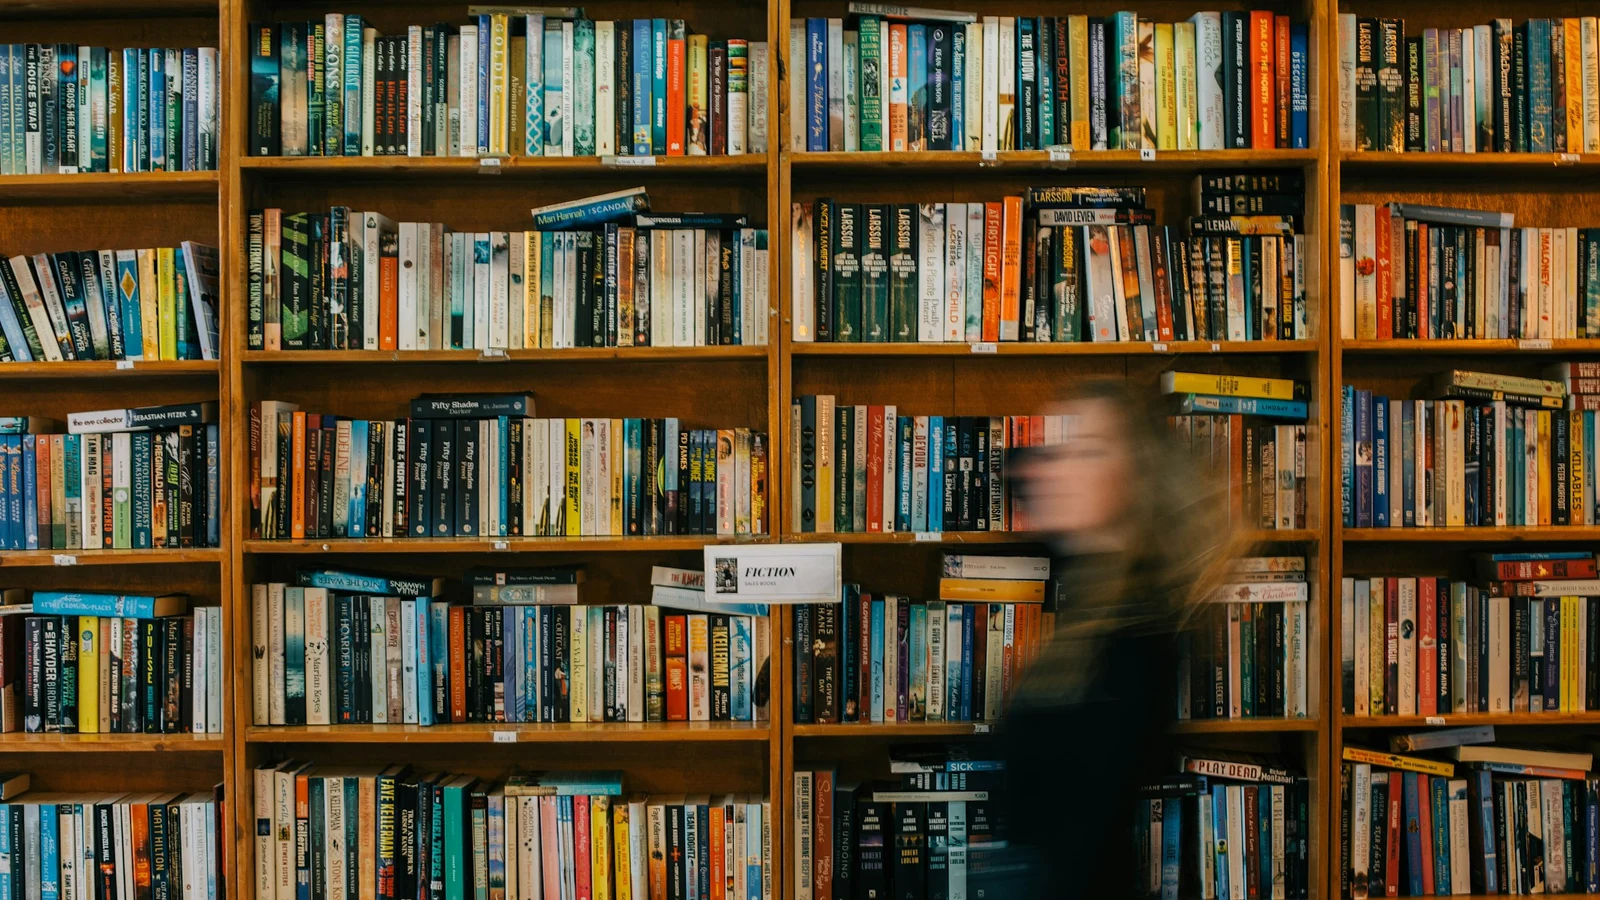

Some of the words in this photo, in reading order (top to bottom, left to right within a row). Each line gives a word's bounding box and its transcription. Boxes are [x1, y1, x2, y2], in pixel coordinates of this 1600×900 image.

[261, 28, 270, 56] GARDNER
[347, 18, 360, 44] ELLEN
[1022, 34, 1032, 49] THE
[1204, 19, 1212, 68] HANCOCK
[1261, 41, 1267, 52] OF
[1359, 23, 1371, 62] LARSSON
[1385, 24, 1397, 63] LARSSON
[326, 45, 339, 89] SONS
[346, 46, 360, 86] GILCHRIST
[494, 24, 503, 93] GOLDIE
[892, 30, 900, 77] detainees
[1021, 50, 1034, 81] WIDOW
[1409, 42, 1418, 83] NICHOLAS
[27, 62, 36, 98] HOUSE
[1292, 52, 1300, 111] DISCOVERER
[1500, 47, 1510, 97] McDermid
[1, 84, 10, 130] MICHAEL
[14, 84, 23, 130] MICHAEL
[67, 83, 75, 108] CROSS
[1043, 77, 1052, 135] mistaken
[1409, 84, 1418, 107] DANE
[28, 102, 37, 129] SWAP
[67, 111, 75, 126] HER
[67, 129, 75, 152] HEART
[250, 214, 262, 232] TONY
[538, 212, 558, 226] Mari
[558, 210, 586, 222] Hannah
[820, 203, 828, 234] ANGELA
[841, 208, 853, 247] LARSSON
[869, 209, 881, 248] LARSSON
[898, 209, 910, 248] LARSSON
[988, 208, 998, 219] AT
[1054, 211, 1072, 222] DAVID
[1073, 211, 1095, 222] LEVIEN
[987, 220, 999, 245] FIRST
[250, 234, 261, 272] HILLERMAN
[820, 236, 828, 271] LAMBERT
[987, 246, 997, 277] LIGHT
[251, 282, 261, 306] TALKING
[950, 291, 958, 323] CHILD
[251, 308, 261, 320] GOD
[310, 305, 319, 326] Lodger
[96, 417, 123, 426] collector
[133, 413, 166, 422] SEBASTIAN
[167, 411, 187, 419] FITZEK
[88, 438, 96, 455] TAMI
[336, 426, 349, 474] TIDELINE
[419, 443, 427, 461] Fifty
[903, 441, 909, 451] AN
[915, 435, 926, 468] DEVOUR
[932, 426, 942, 473] sightseeing
[88, 457, 96, 475] HOAG
[154, 445, 163, 488] REGINALD
[1572, 451, 1581, 510] KILLABLES
[155, 489, 164, 507] HILL
[744, 566, 796, 577] FICTION
[341, 619, 350, 667] HOARDER
[1388, 622, 1397, 638] THE
[46, 640, 56, 680] HAYDER
[168, 643, 177, 674] Hannah
[713, 632, 728, 686] KELLERMAN
[1388, 639, 1397, 664] VOGUE
[47, 682, 56, 718] BIRDMAN
[314, 690, 322, 713] Keyes
[950, 763, 974, 771] SICK
[1198, 761, 1226, 774] PLAY
[1229, 765, 1258, 778] DEAD
[1261, 772, 1294, 784] Montanari
[381, 779, 394, 801] FAYE
[153, 809, 162, 834] MATT
[433, 803, 442, 839] ANGEL
[652, 808, 660, 820] Faye
[380, 804, 394, 858] KELLERMAN
[687, 832, 695, 859] KOONTZ
[154, 837, 164, 870] HILTON
[433, 841, 442, 877] TAPES
